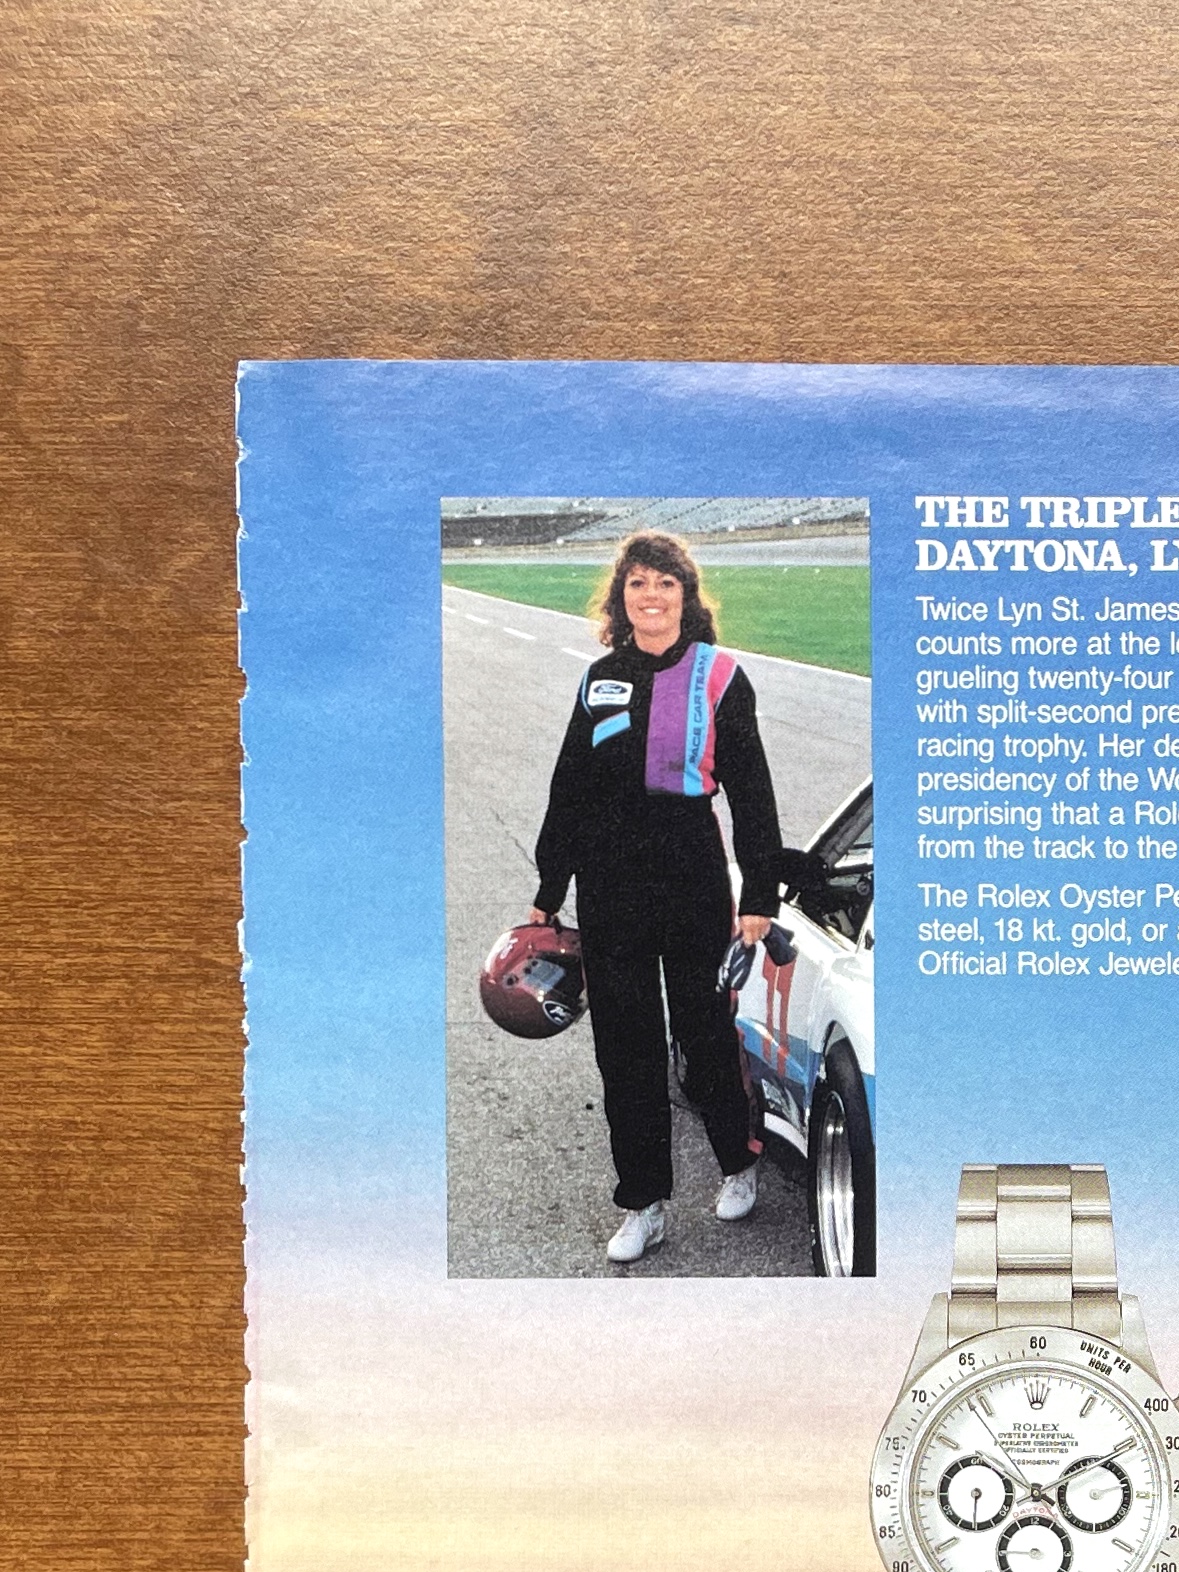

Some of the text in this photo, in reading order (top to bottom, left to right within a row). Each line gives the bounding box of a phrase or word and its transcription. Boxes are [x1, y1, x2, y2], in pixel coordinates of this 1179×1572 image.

[914, 495, 1010, 528] THE
[914, 538, 1139, 577] DAYTONA,
[914, 595, 989, 623] Twice
[998, 596, 1042, 628] Lyn
[1051, 595, 1085, 622] St.
[915, 631, 1003, 656] counts
[1011, 635, 1078, 656] more
[1086, 631, 1112, 656] at
[1118, 630, 1161, 656] the
[915, 664, 1019, 696] grueling
[1027, 664, 1175, 697] twenty-four
[693, 695, 703, 723] CAR
[916, 698, 968, 724] with
[976, 698, 1133, 730] split-second
[917, 882, 968, 909] The
[977, 883, 1051, 909] Rolex
[1059, 882, 1147, 915] Oyster
[918, 949, 1007, 976] Official
[1017, 950, 1091, 976] Rolex
[1029, 1336, 1047, 1350] 60
[958, 1353, 976, 1366] 65
[1080, 1340, 1132, 1374] UNITS PER
[1088, 1358, 1113, 1376] HOUR
[911, 1390, 927, 1403] 70
[1143, 1398, 1169, 1412] 400
[1012, 1422, 1060, 1432] ROLEX
[879, 1526, 896, 1539] 85
